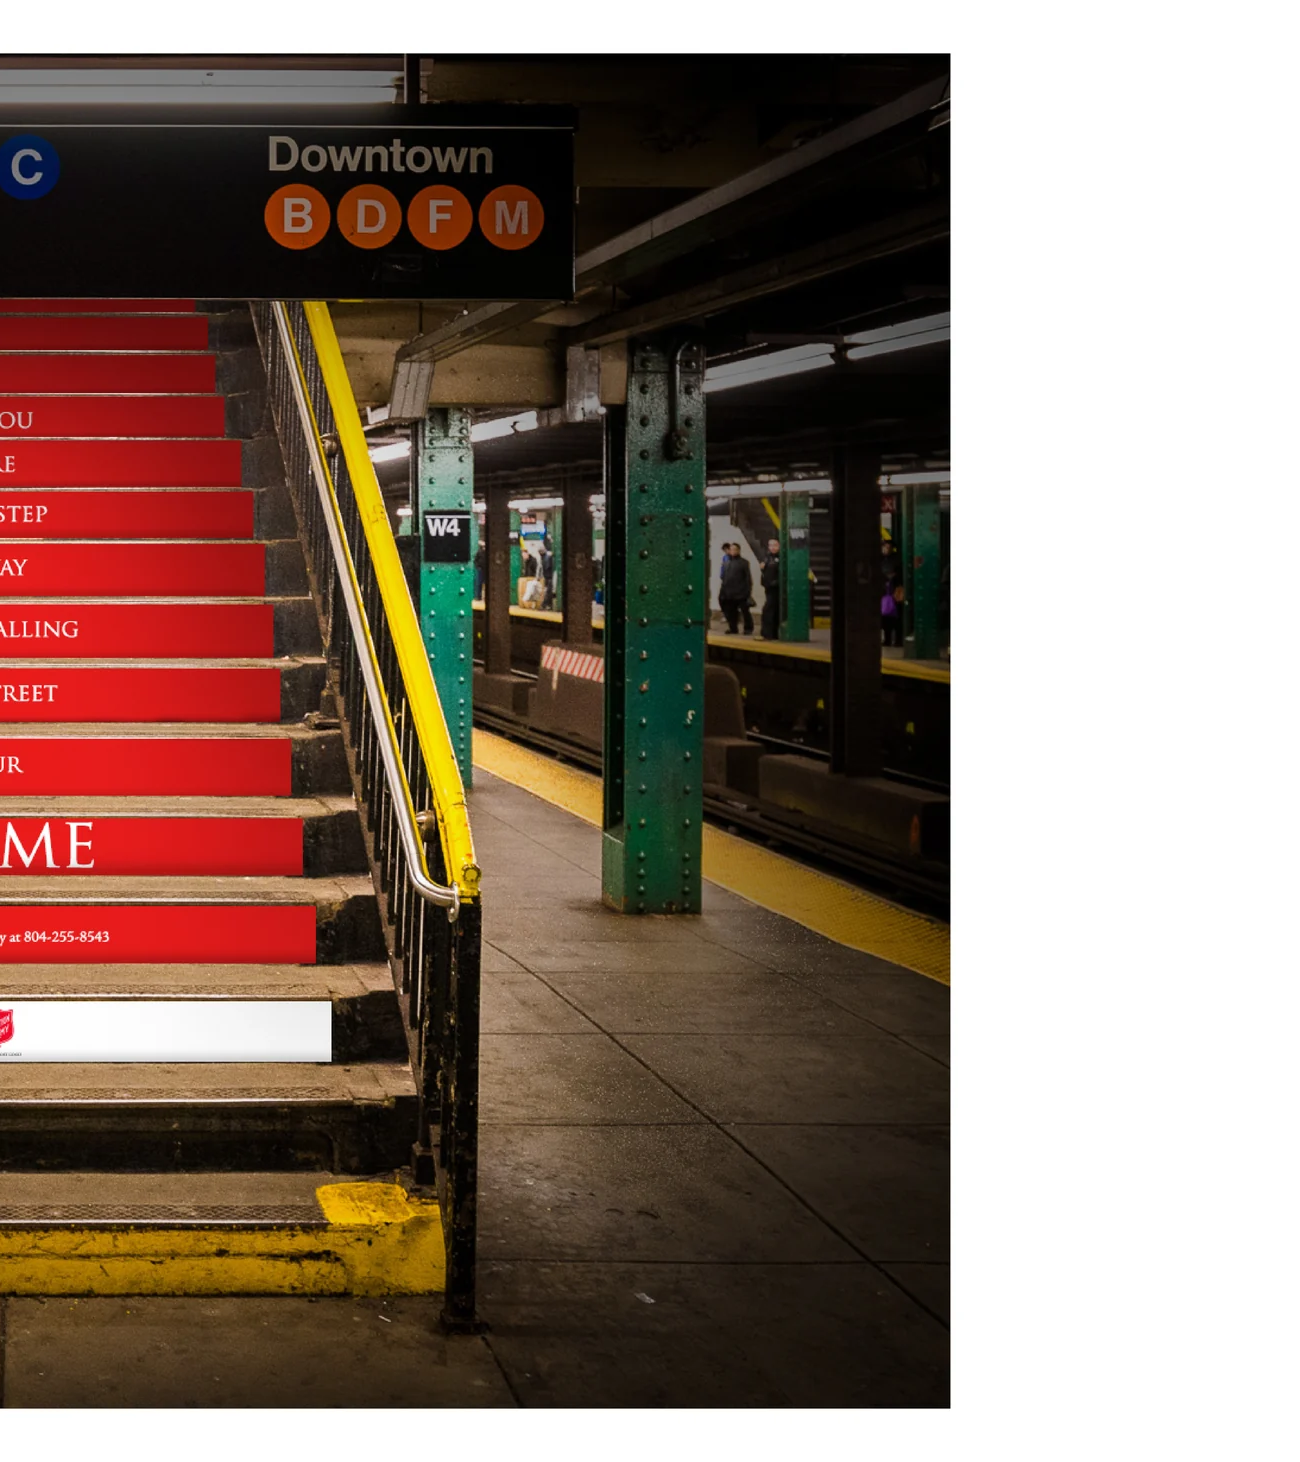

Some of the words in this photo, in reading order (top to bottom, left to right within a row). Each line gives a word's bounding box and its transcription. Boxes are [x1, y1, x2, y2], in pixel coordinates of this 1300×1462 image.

[11, 148, 44, 185] C
[269, 136, 493, 173] Downtown
[283, 198, 313, 233] B
[357, 199, 387, 233] D
[429, 199, 454, 233] F
[496, 201, 529, 234] M
[426, 518, 461, 537] W4
[8, 932, 21, 943] at
[23, 930, 110, 943] 804-255-8543
